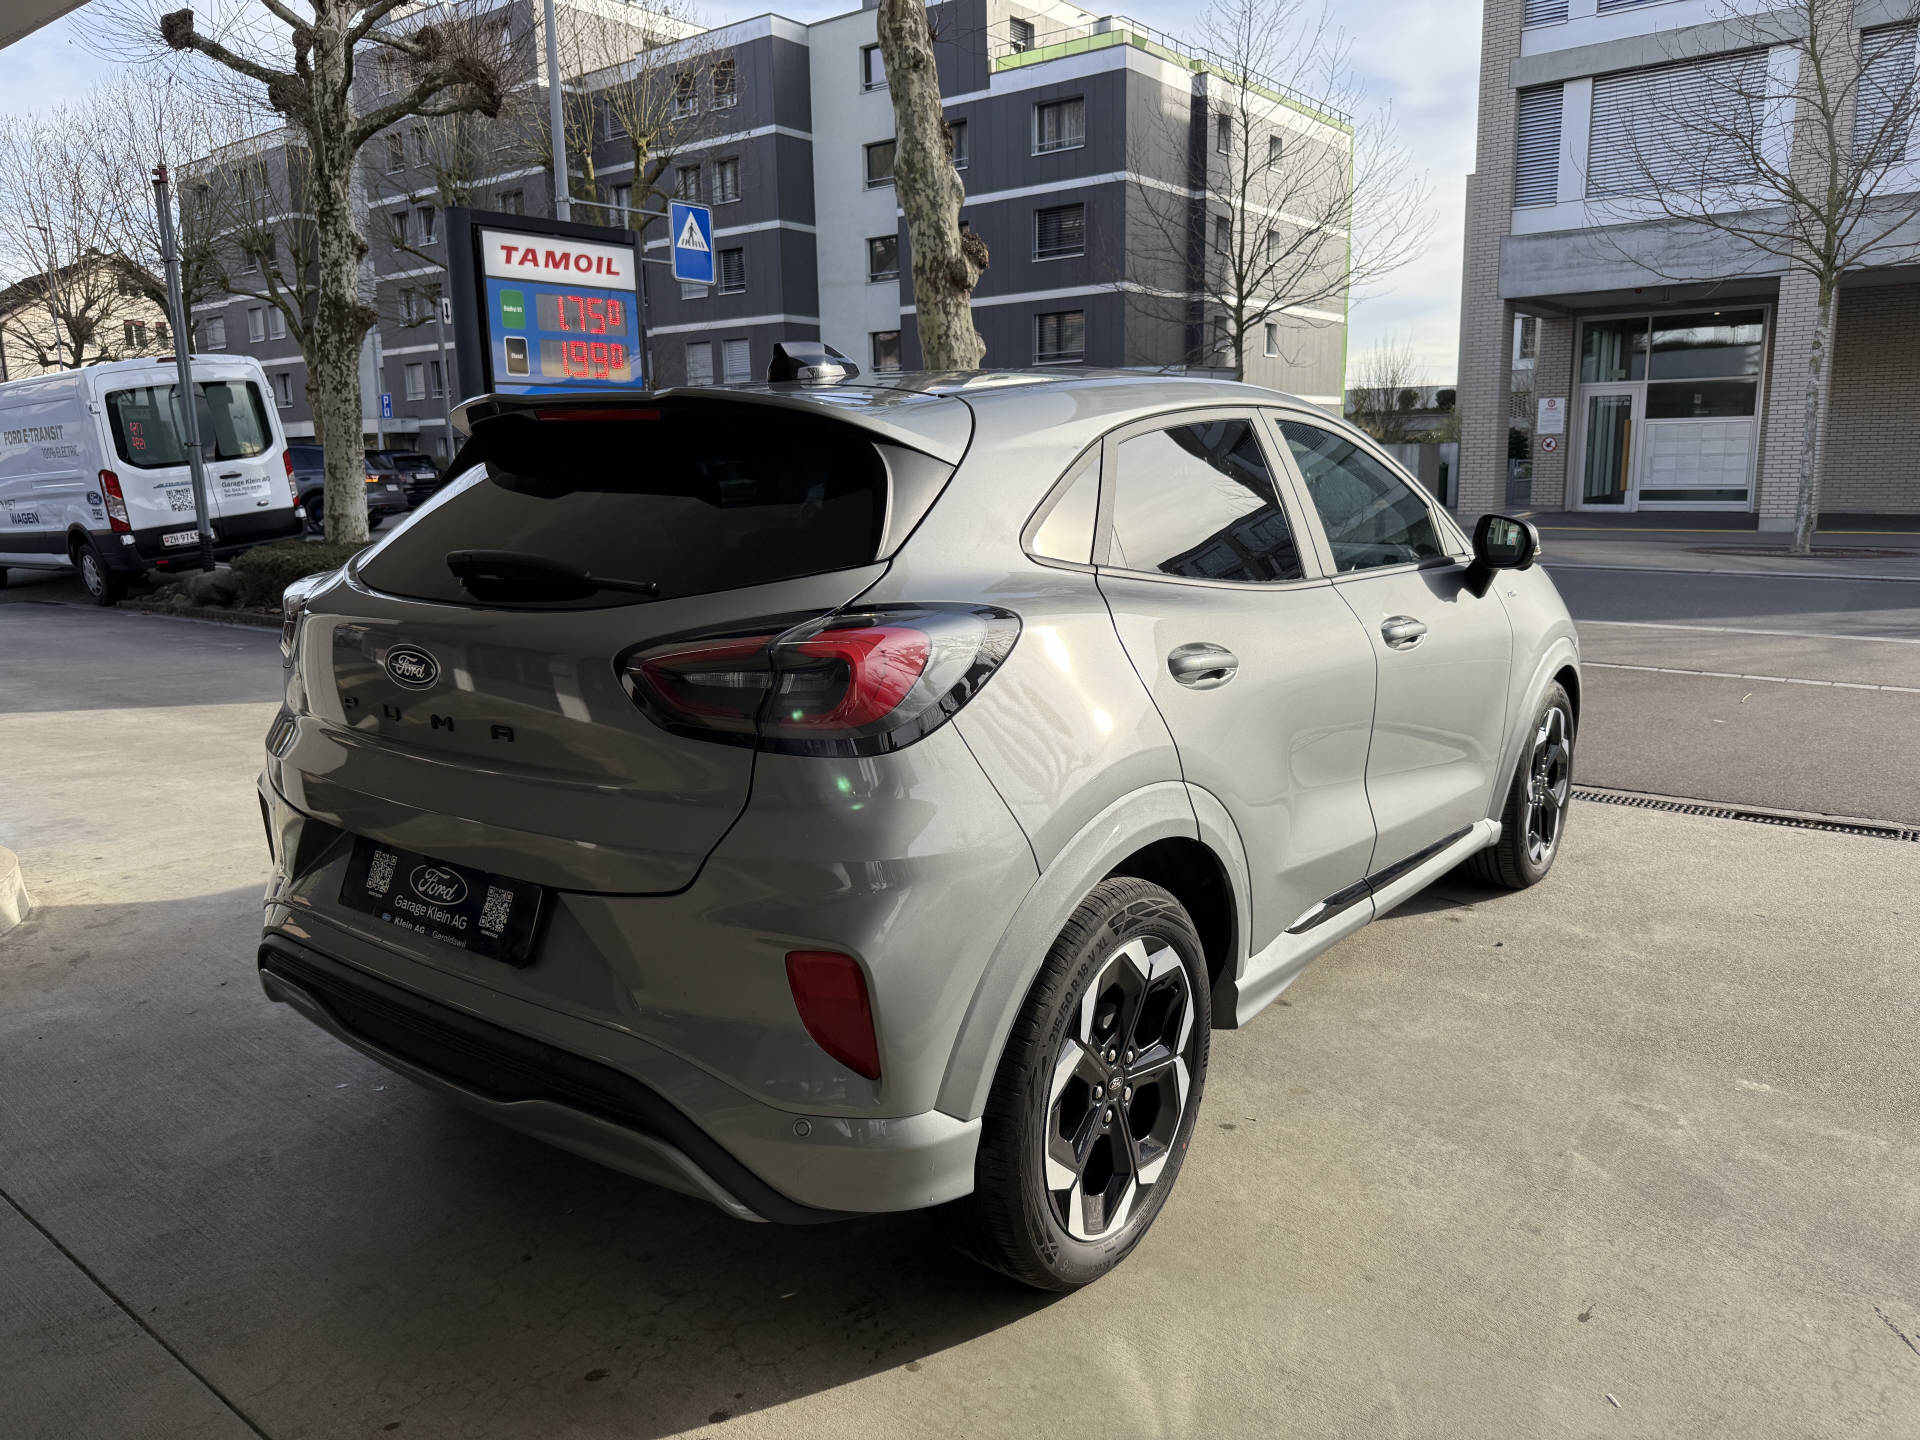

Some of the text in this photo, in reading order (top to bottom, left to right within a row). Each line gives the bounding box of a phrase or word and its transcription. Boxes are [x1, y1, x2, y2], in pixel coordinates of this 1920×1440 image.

[500, 244, 621, 277] TAMOIL
[3, 425, 63, 445] FORD E-TRANSIT
[221, 480, 244, 488] Garage
[9, 512, 40, 525] WAGEN
[344, 696, 515, 743] PUMA
[418, 867, 459, 902] Ford
[393, 916, 413, 930] Klein
[414, 923, 425, 934] AG
[394, 894, 427, 918] Garage
[426, 904, 451, 924] Klein
[451, 914, 468, 930] AG
[1048, 936, 1109, 1044] 215/50 R 18 V XL
